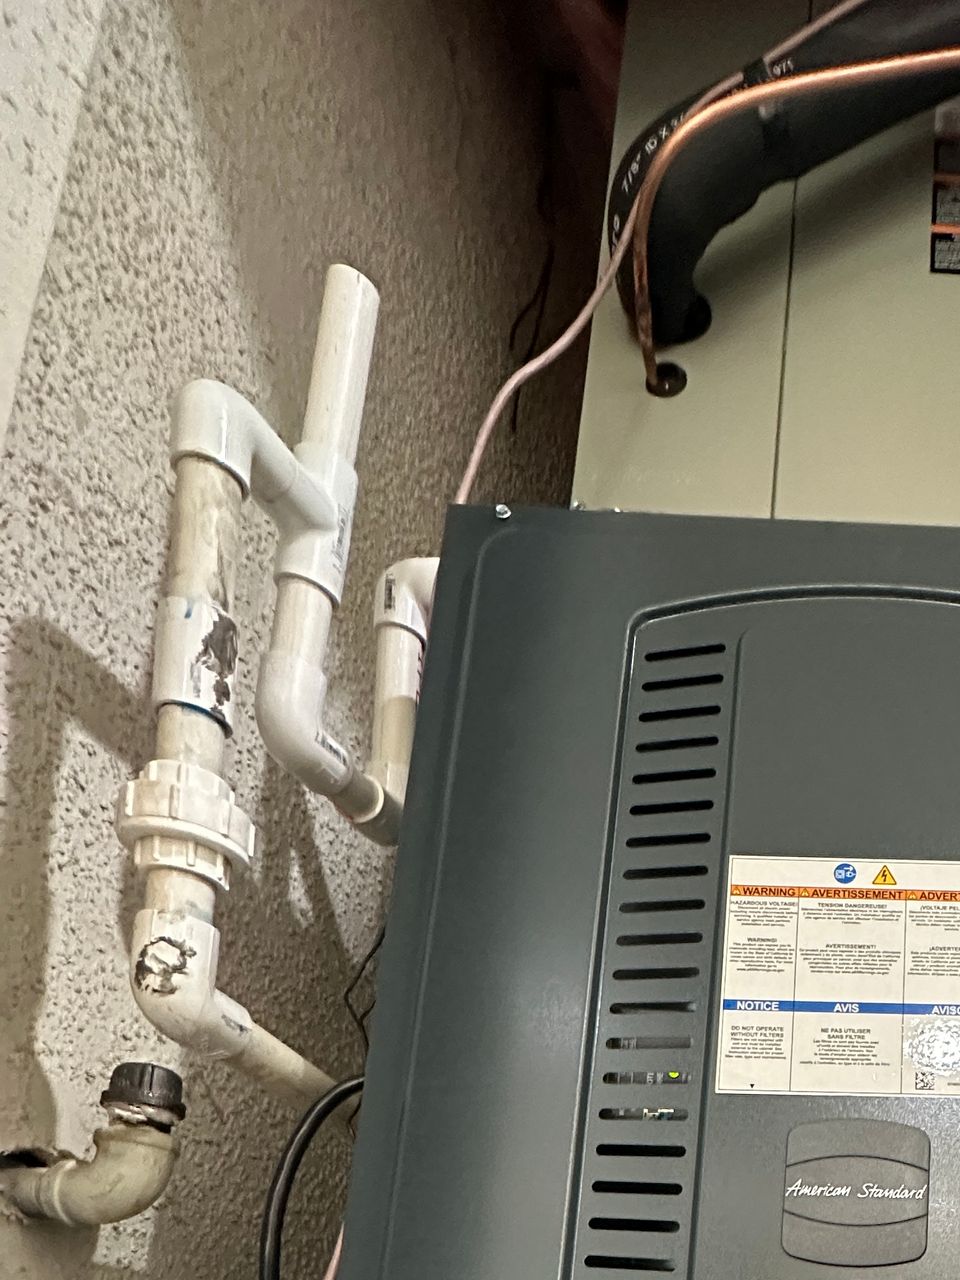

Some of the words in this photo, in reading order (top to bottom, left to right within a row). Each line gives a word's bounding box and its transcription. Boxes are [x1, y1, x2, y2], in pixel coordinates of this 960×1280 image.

[743, 887, 796, 897] WARNING
[812, 889, 904, 900] AVERTISSEMENT
[737, 1001, 780, 1011] NOTICE
[833, 1003, 860, 1014] AVIS
[785, 1178, 852, 1198] American
[857, 1182, 928, 1200] Standard
